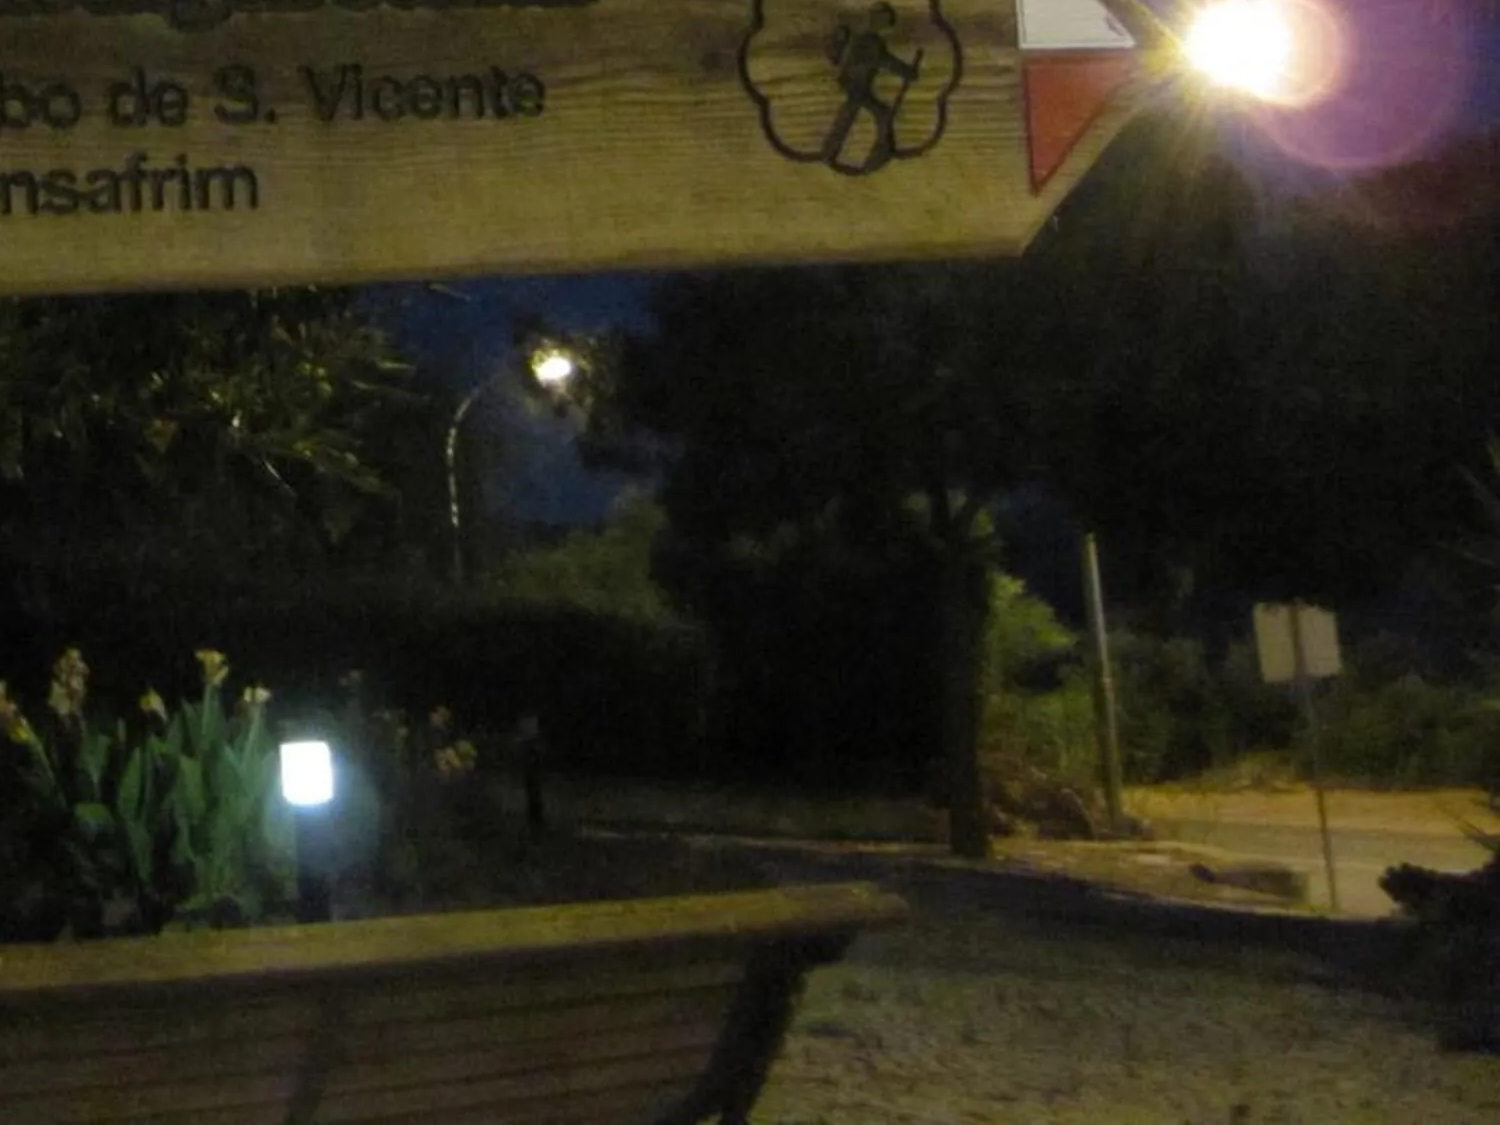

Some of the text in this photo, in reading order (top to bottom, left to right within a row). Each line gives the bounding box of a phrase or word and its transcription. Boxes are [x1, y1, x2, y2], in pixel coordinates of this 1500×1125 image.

[108, 67, 190, 128] de
[214, 65, 278, 126] S.
[300, 62, 548, 124] Vicente
